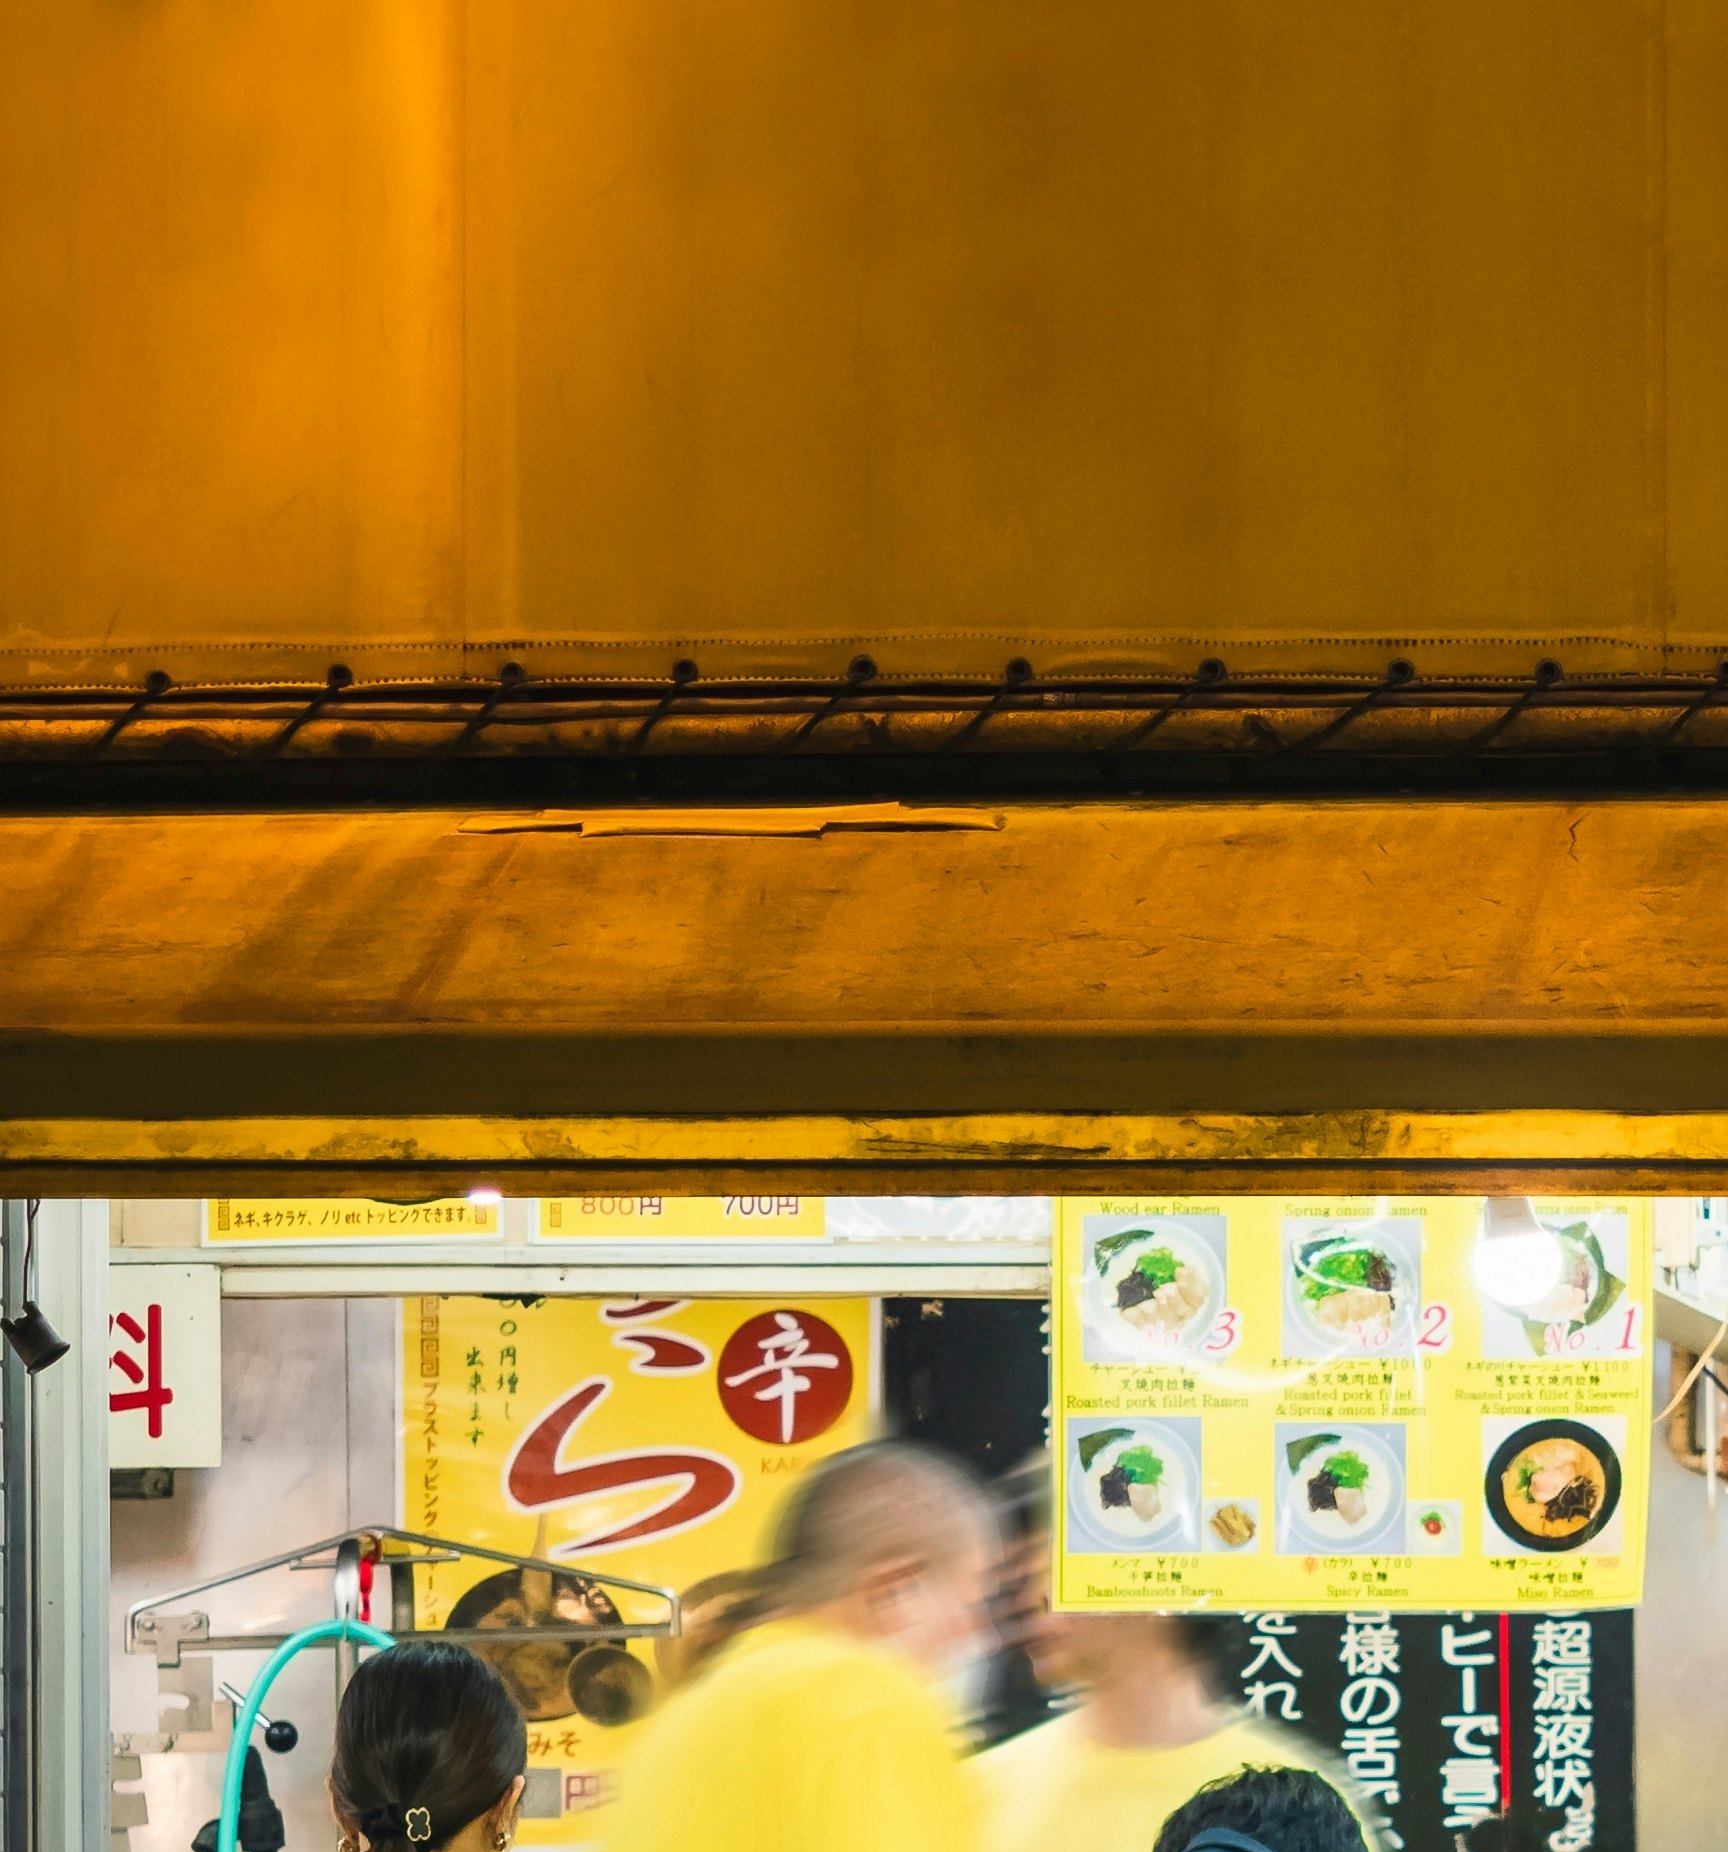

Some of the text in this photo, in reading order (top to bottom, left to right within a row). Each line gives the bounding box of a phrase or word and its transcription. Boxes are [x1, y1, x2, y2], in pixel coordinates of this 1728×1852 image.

[581, 1196, 662, 1215] 800円
[722, 1196, 798, 1215] 700円
[1099, 1202, 1220, 1215] Wood ear Ramen
[1285, 1204, 1427, 1218] Spring onion amen
[724, 1312, 838, 1443] 辛
[1284, 1389, 1337, 1401] Roasted
[1343, 1389, 1372, 1402] pork
[1455, 1389, 1501, 1400] Roasted
[1507, 1389, 1533, 1402] pork
[1066, 1395, 1249, 1410] Roasted pork fillet Ramen
[1574, 1402, 1615, 1414] Ramen
[1339, 1404, 1375, 1416] onion
[1181, 1585, 1223, 1597] Ramen
[1326, 1584, 1409, 1598] Spicy Ramen
[1518, 1586, 1594, 1598] Miso Ramen
